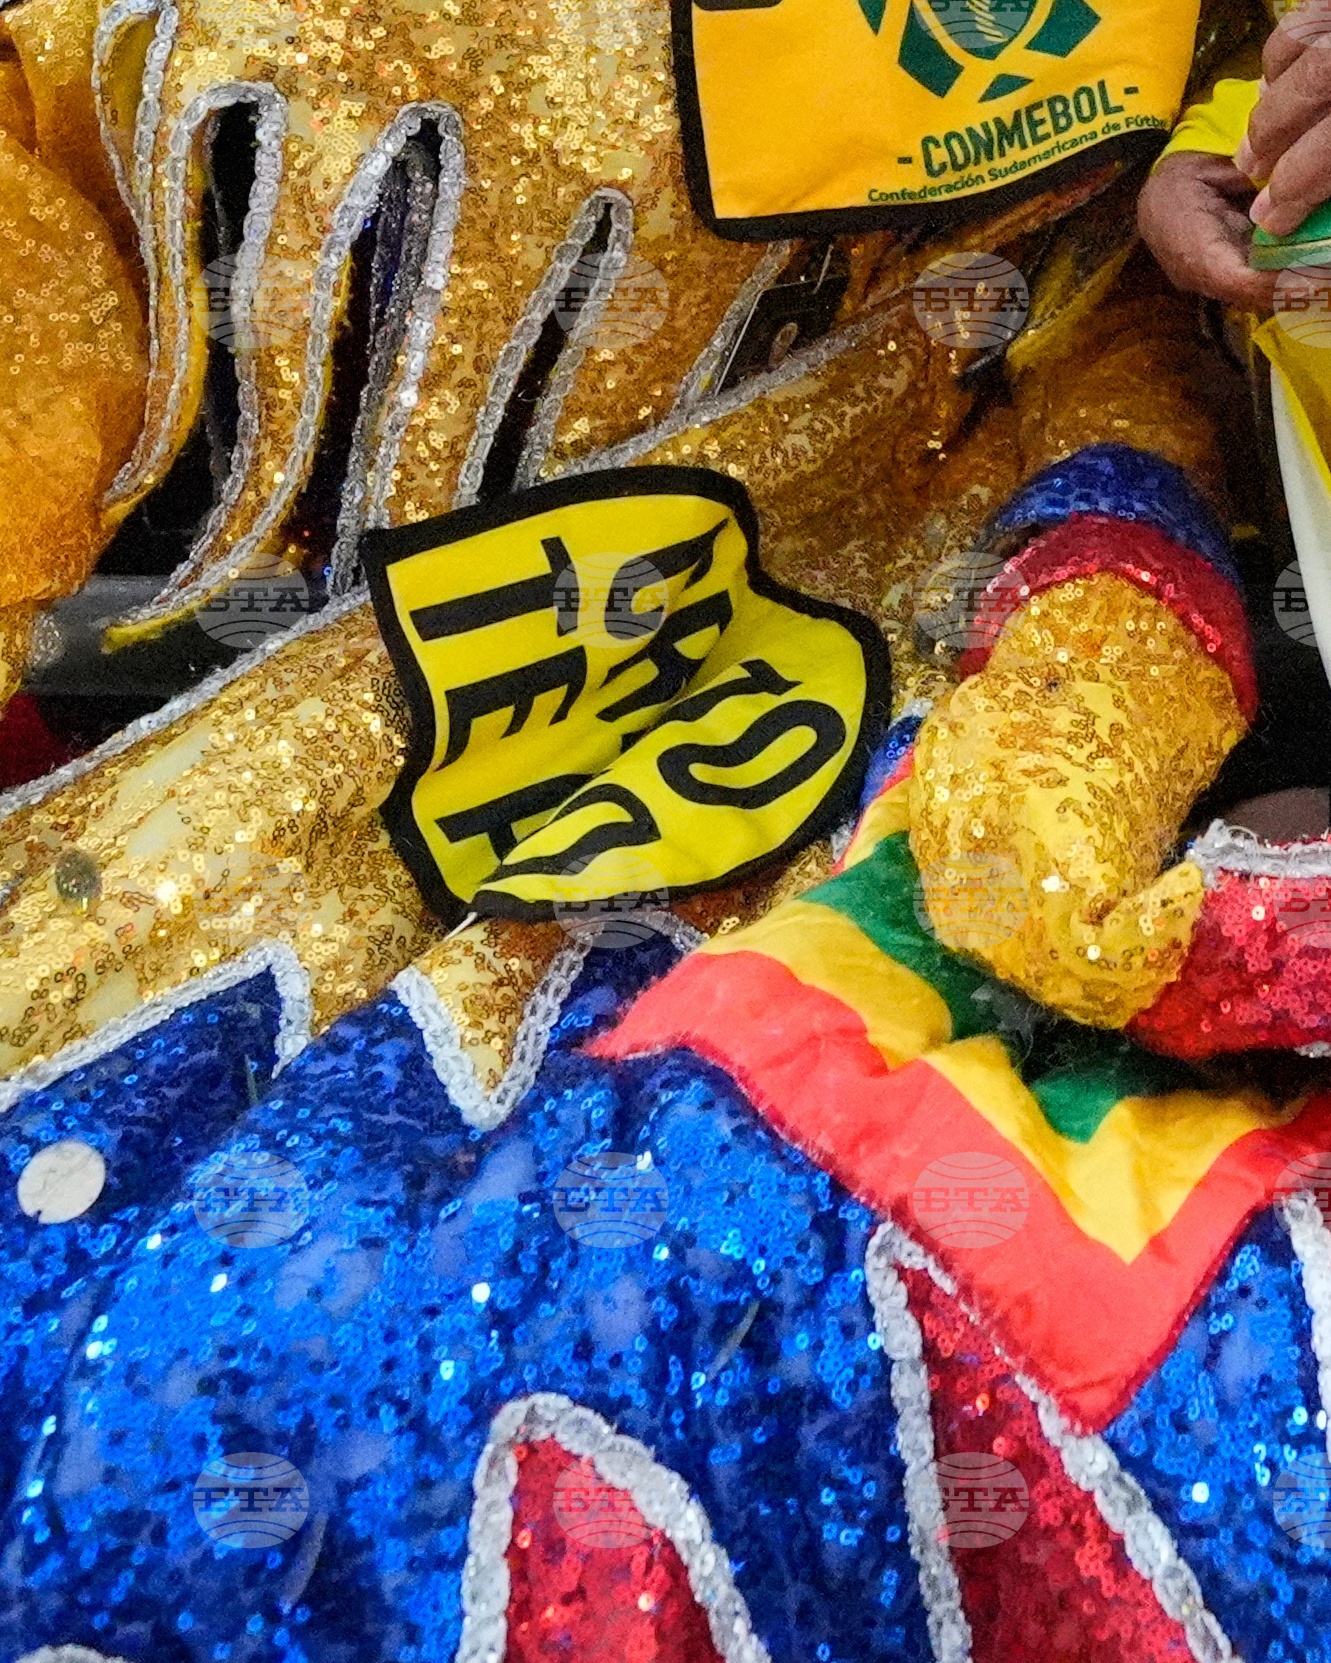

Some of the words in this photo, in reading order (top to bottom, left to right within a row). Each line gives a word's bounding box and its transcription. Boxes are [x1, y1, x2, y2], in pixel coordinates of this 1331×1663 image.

[868, 172, 986, 203] Confederación
[988, 130, 1098, 181] Sudamericana
[1101, 119, 1121, 135] de
[921, 80, 1124, 178] CONMEBOL
